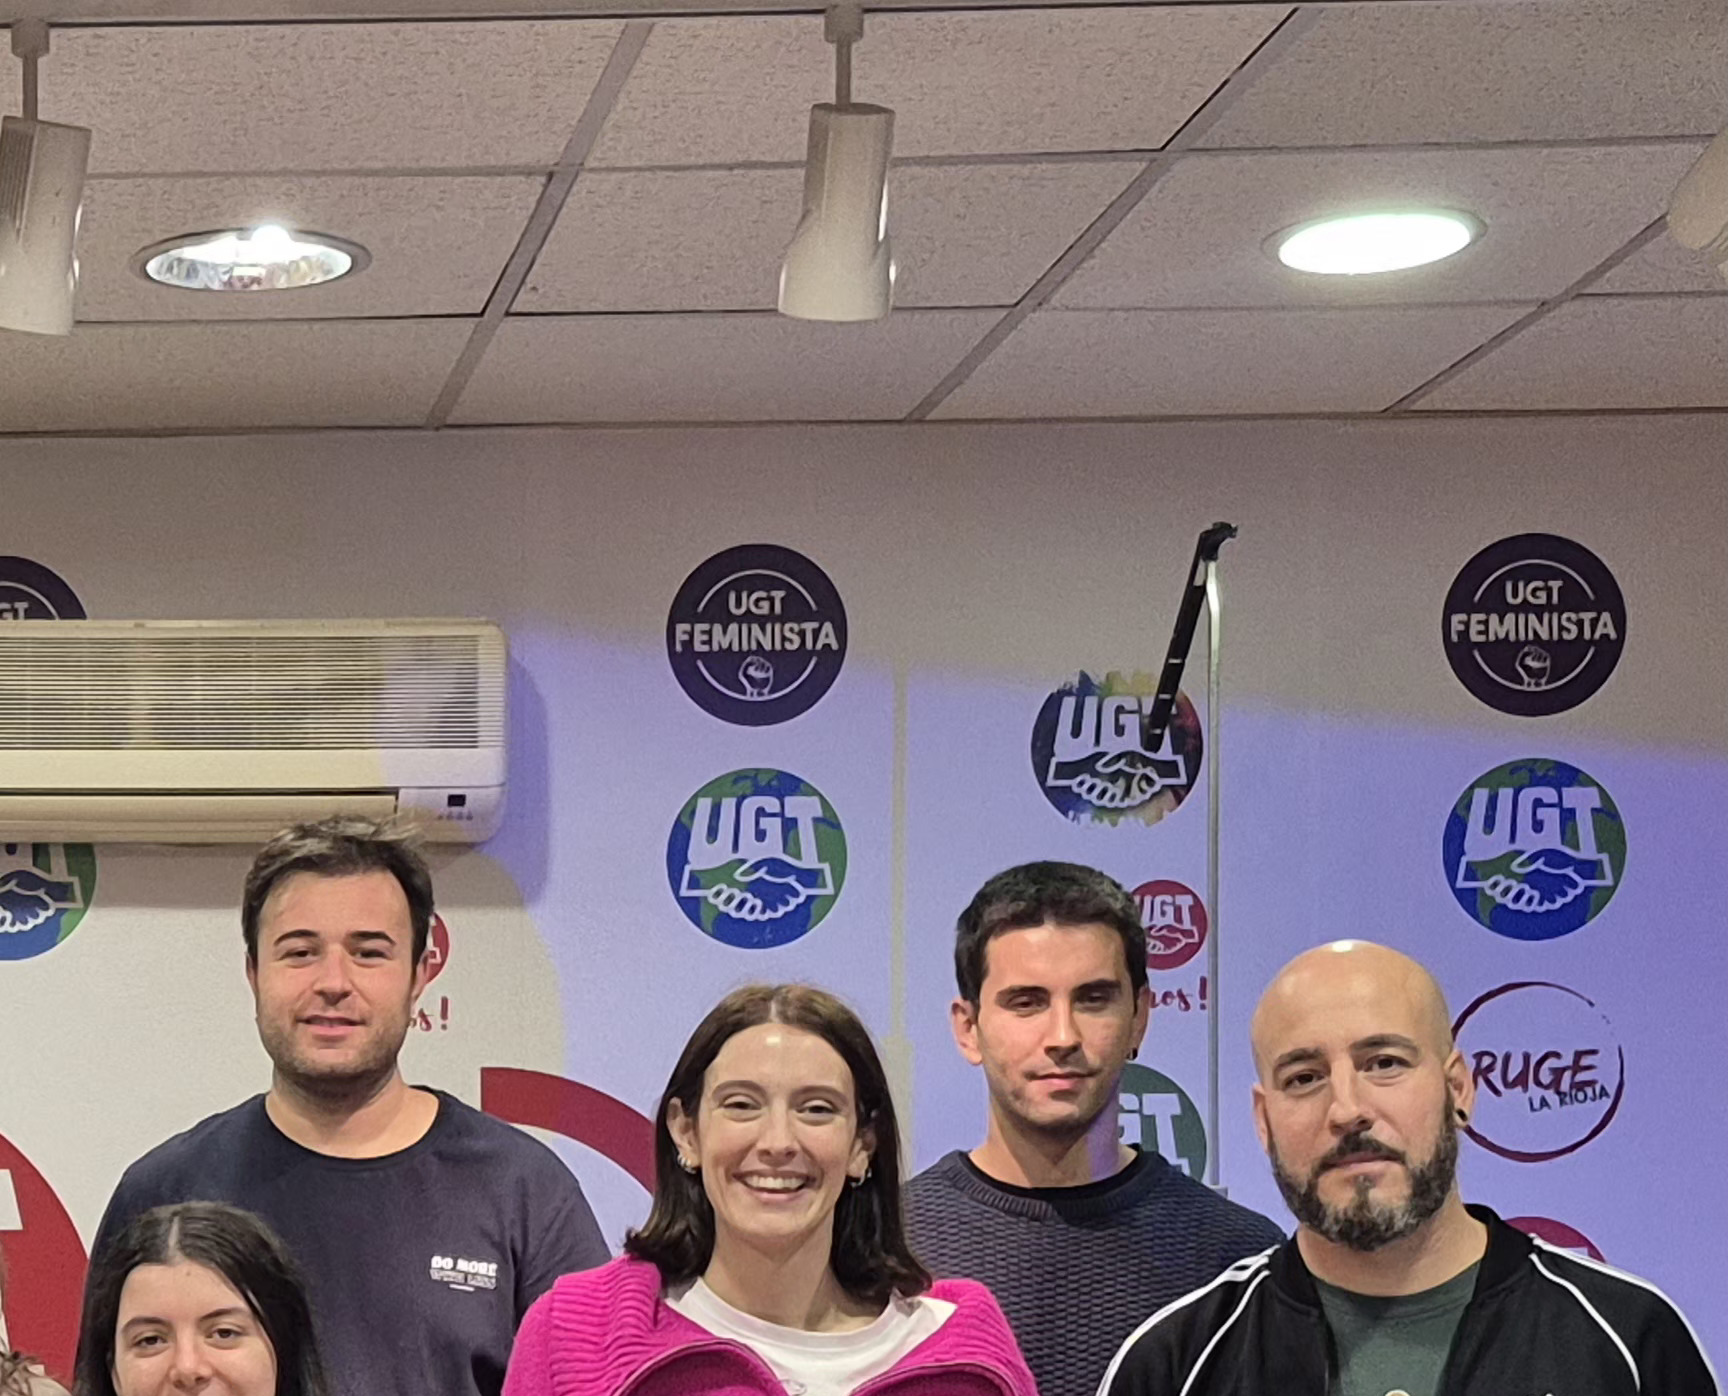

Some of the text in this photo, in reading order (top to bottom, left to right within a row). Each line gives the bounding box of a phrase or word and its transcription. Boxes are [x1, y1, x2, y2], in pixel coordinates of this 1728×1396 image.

[728, 590, 786, 616] UGT
[1505, 580, 1563, 606] UGT
[675, 622, 839, 653] FEMINISTA
[1450, 611, 1618, 643] FEMINISTA
[688, 795, 823, 866] UGT
[1465, 786, 1601, 858] UGT
[1472, 1049, 1600, 1097] RUGE
[1528, 1083, 1610, 1113] LA RIOJA
